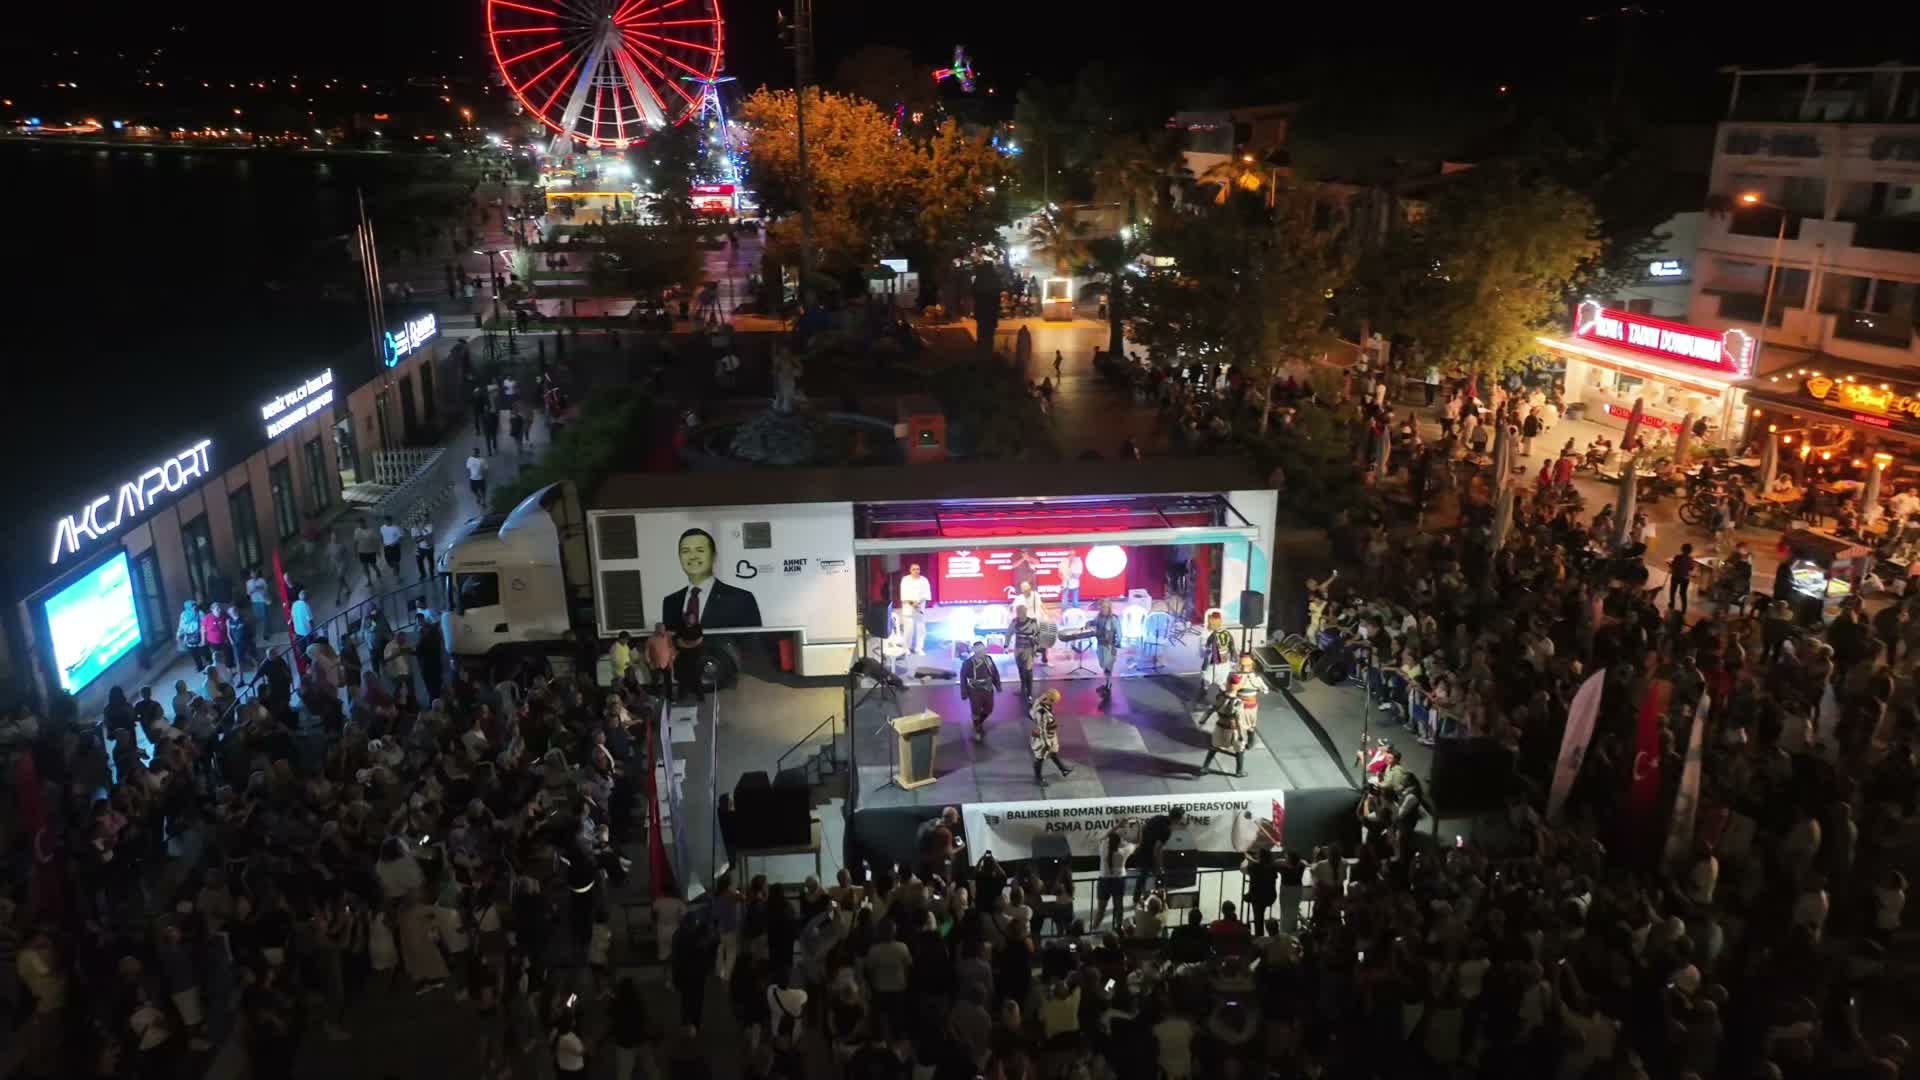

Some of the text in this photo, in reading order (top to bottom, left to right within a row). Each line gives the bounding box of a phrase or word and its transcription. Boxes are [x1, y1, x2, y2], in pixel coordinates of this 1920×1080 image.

[784, 558, 807, 566] AHMET
[1007, 808, 1060, 820] BALIKESİR
[1063, 806, 1101, 817] ROMAN
[1046, 821, 1081, 832] ASMA
